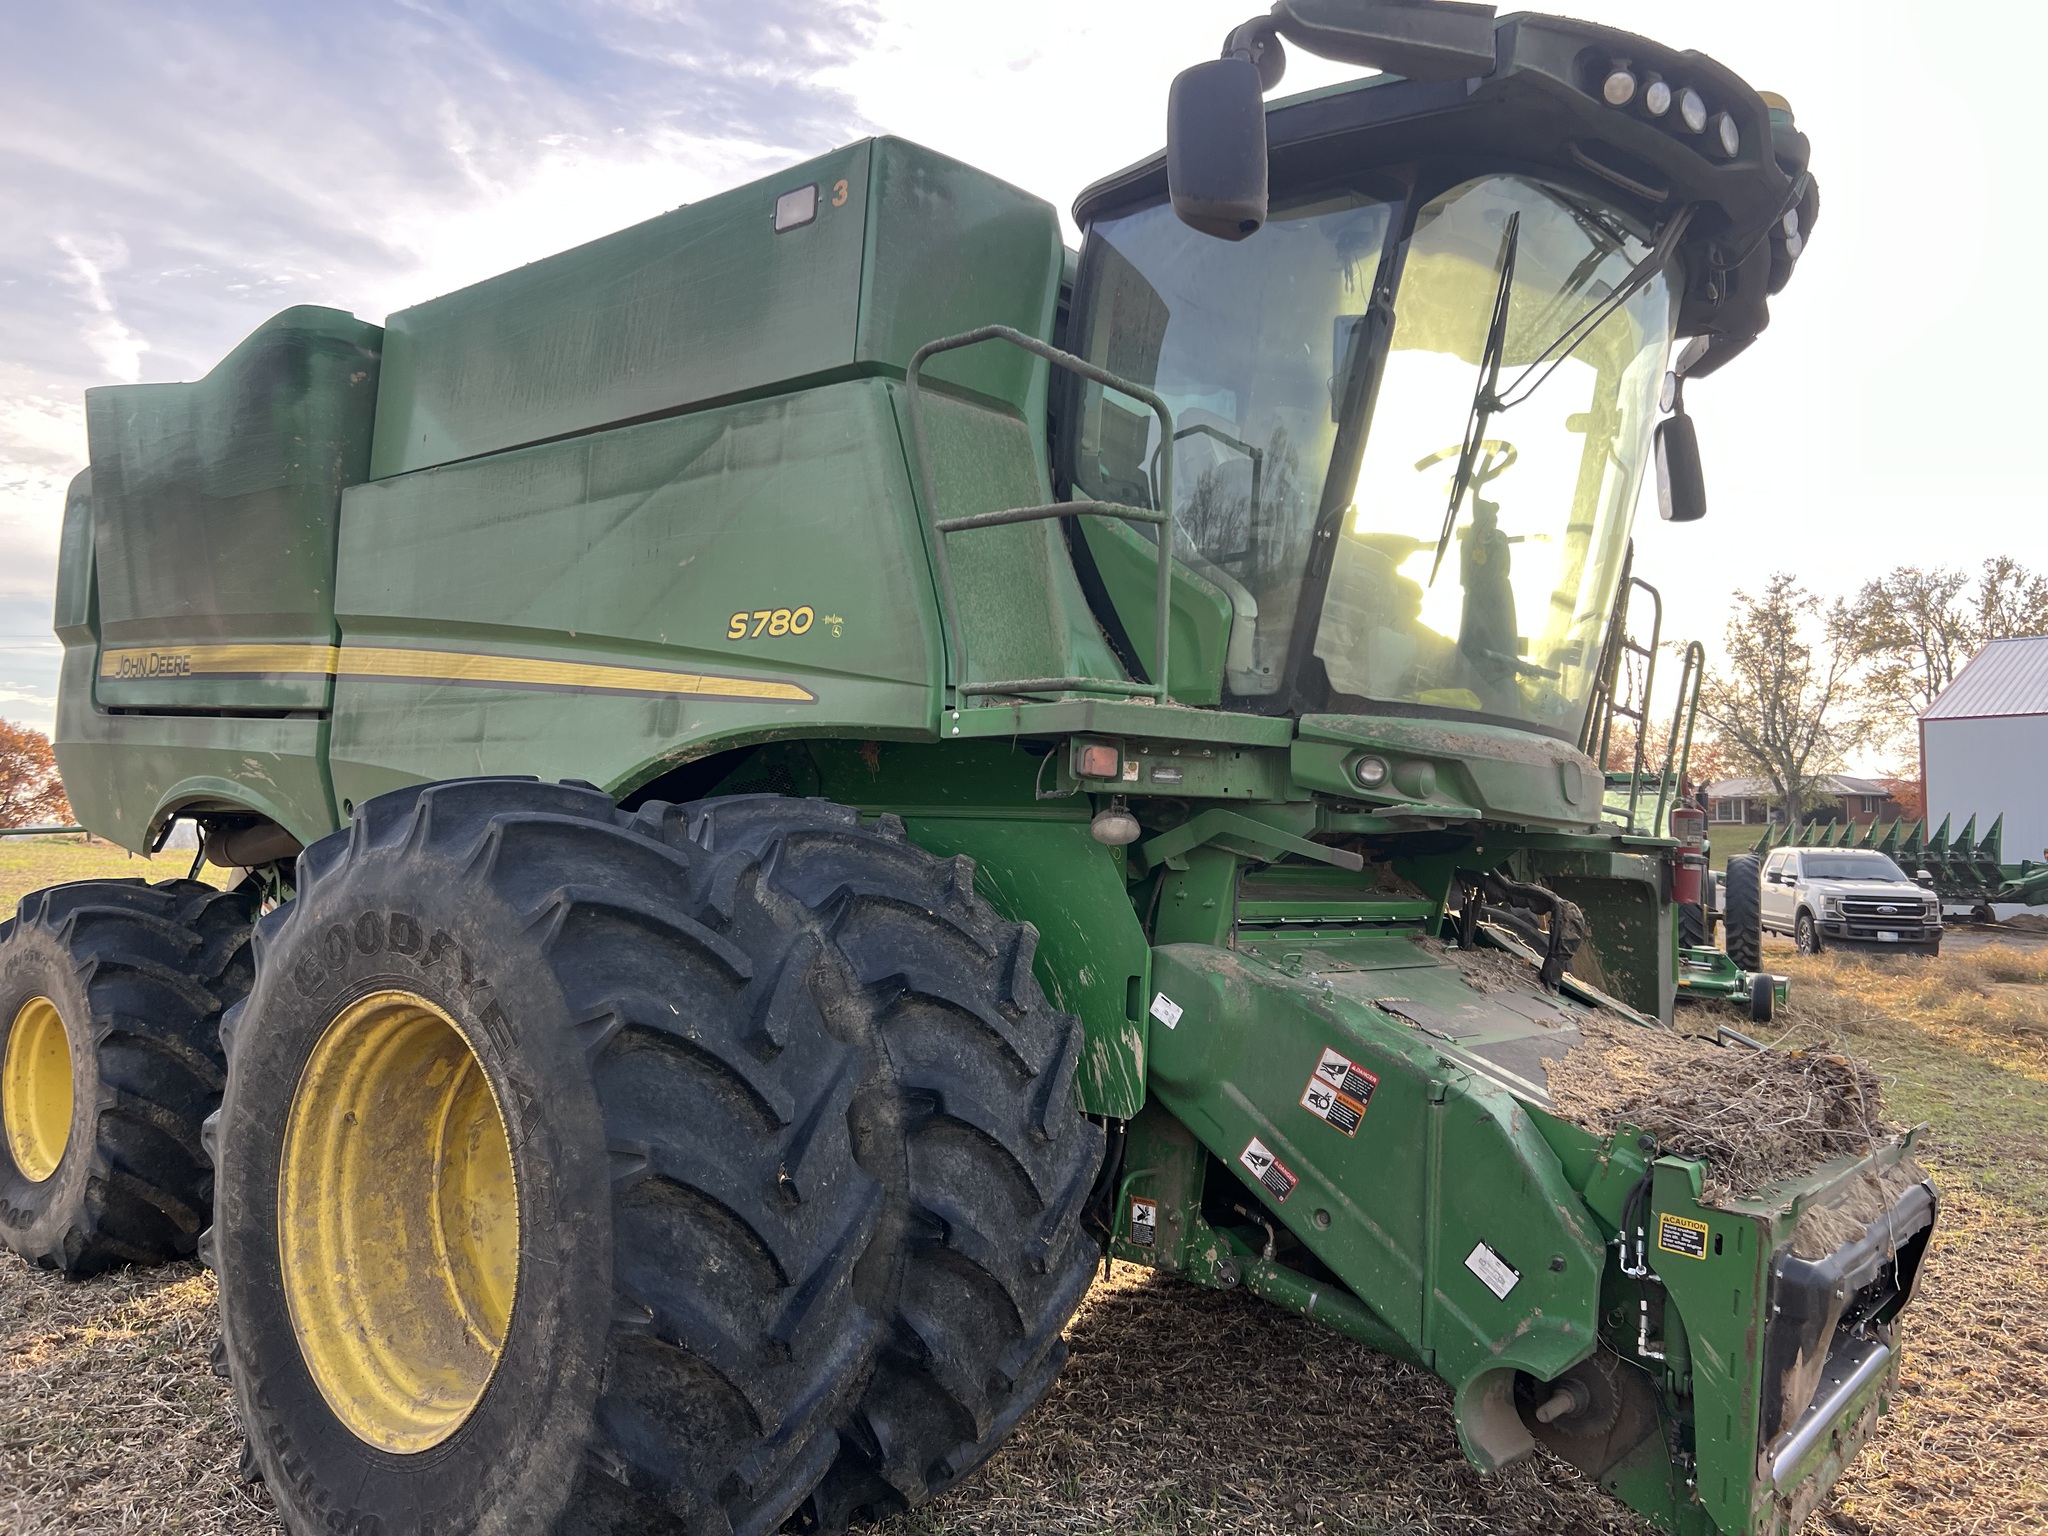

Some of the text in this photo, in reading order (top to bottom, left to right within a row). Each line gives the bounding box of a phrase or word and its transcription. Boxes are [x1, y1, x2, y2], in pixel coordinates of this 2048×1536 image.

[832, 179, 849, 207] 3
[726, 605, 815, 640] S780
[115, 652, 191, 678] JOHN DEERE
[1356, 1067, 1377, 1083] DANGER
[1277, 1163, 1297, 1183] DANGER
[1670, 1217, 1706, 1231] CAUTION
